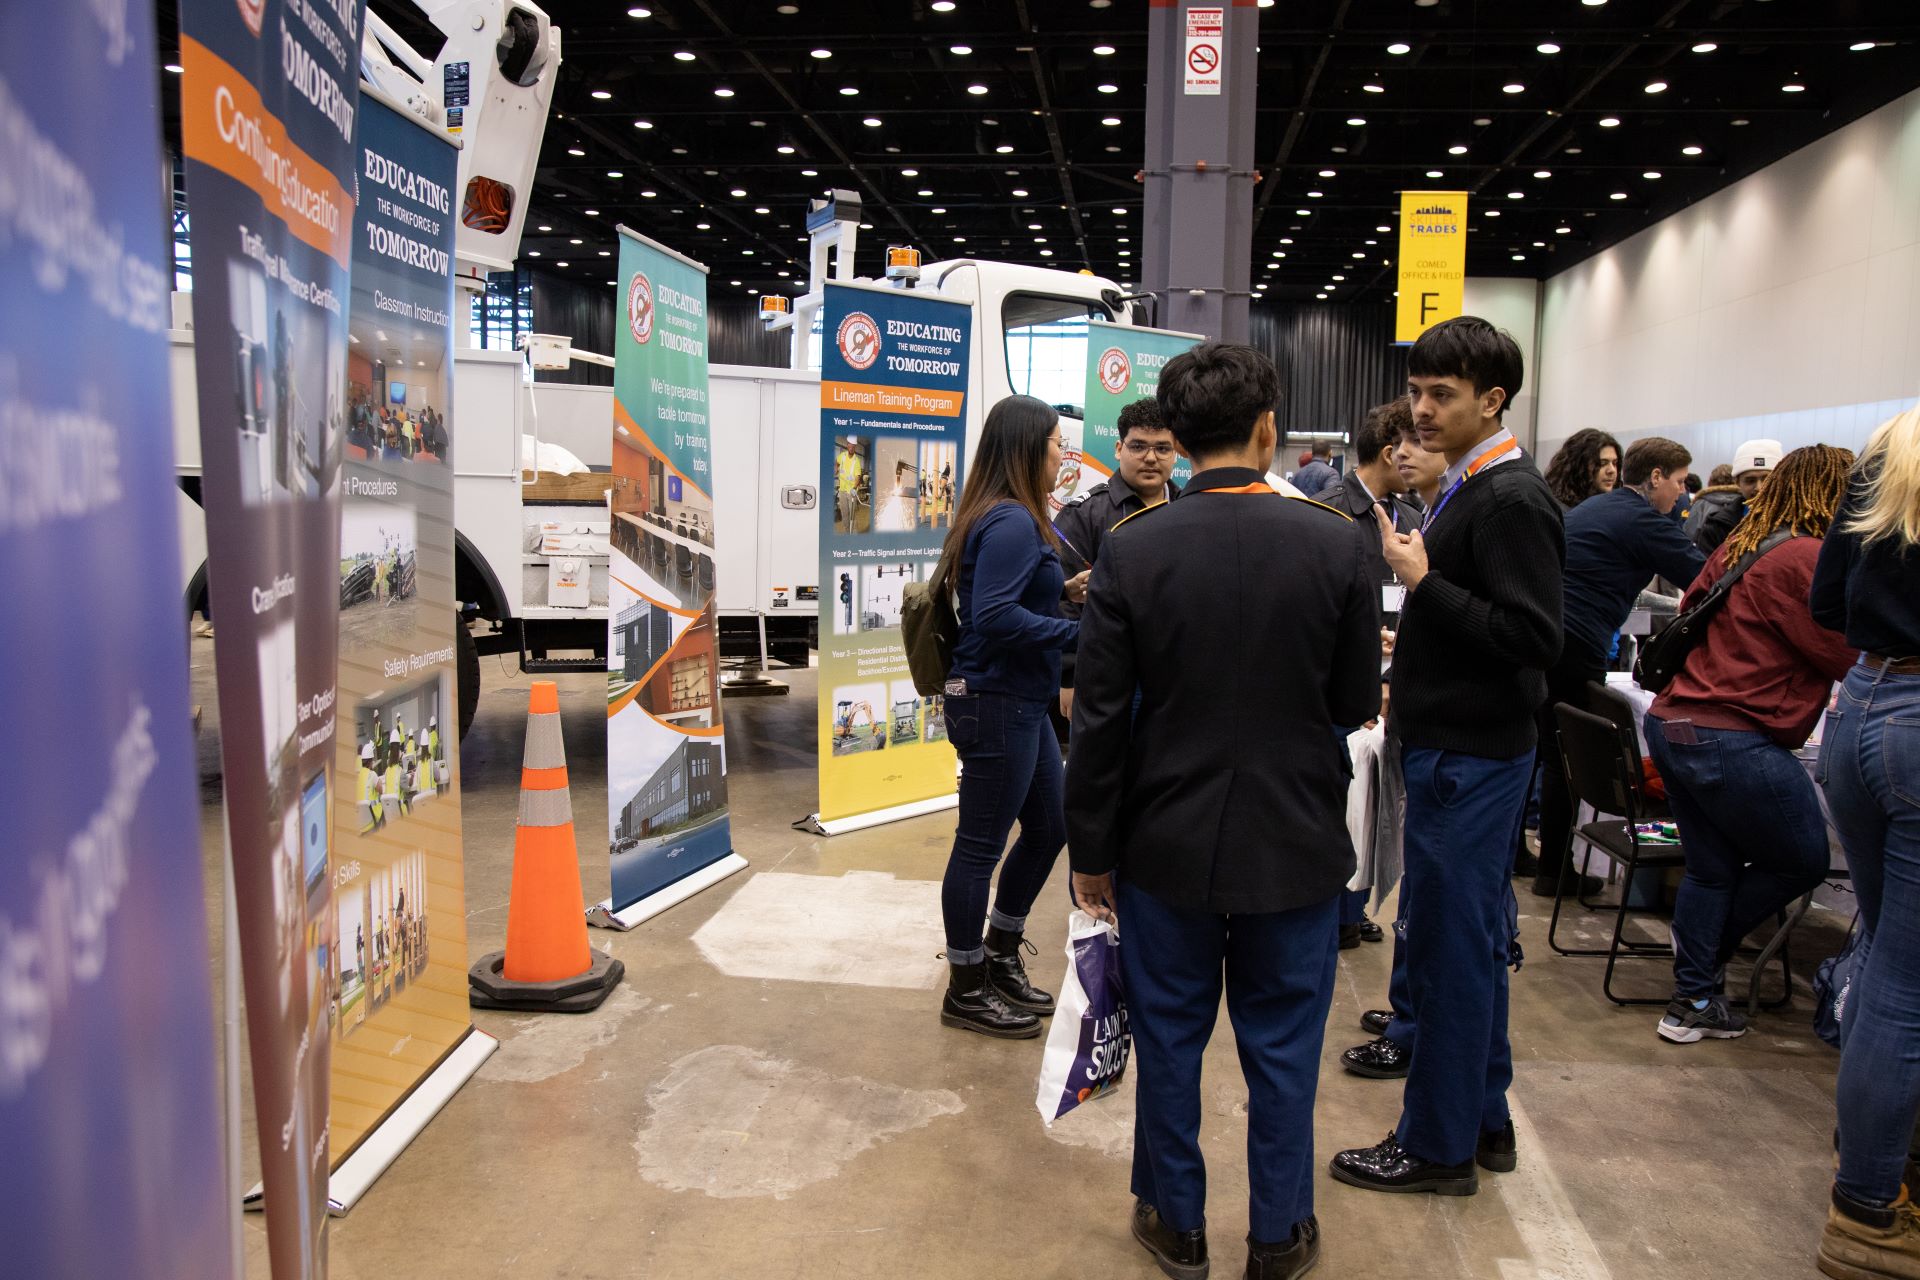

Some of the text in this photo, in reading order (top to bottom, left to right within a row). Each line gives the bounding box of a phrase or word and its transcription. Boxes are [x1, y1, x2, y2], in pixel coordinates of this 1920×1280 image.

[364, 147, 449, 216] EDUCATING
[377, 197, 440, 236] THE WORKFORCE OF
[366, 220, 449, 277] TOMORROW
[1401, 272, 1462, 280] OFFICE & FIELD
[1416, 260, 1447, 269] COMED
[374, 289, 450, 328] Classroom Instruction
[658, 284, 702, 318] EDUCATING
[1420, 292, 1440, 325] F
[886, 319, 962, 343] EDUCATING
[658, 329, 703, 358] TOMORROW
[897, 342, 951, 356] THE WORKFORCE OF
[886, 355, 961, 377] TOMORROW
[651, 377, 705, 403] We're prepared to
[833, 387, 953, 411] Lineman Training Program
[677, 409, 706, 426] tomorrow
[833, 417, 848, 427] Year
[860, 419, 902, 430] Fundamentals
[902, 421, 913, 430] and
[913, 421, 945, 432] Procedures
[674, 431, 707, 453] by training
[1094, 424, 1109, 437] We
[352, 476, 397, 496] Procedures
[832, 550, 847, 559] Year
[858, 549, 877, 558] Traffic
[877, 549, 896, 558] Signal
[896, 548, 906, 557] and
[906, 547, 923, 556] Street
[924, 547, 944, 557] Lightin
[384, 644, 454, 678] Safety Requirements
[831, 649, 846, 659] Year
[339, 859, 360, 886] Skills
